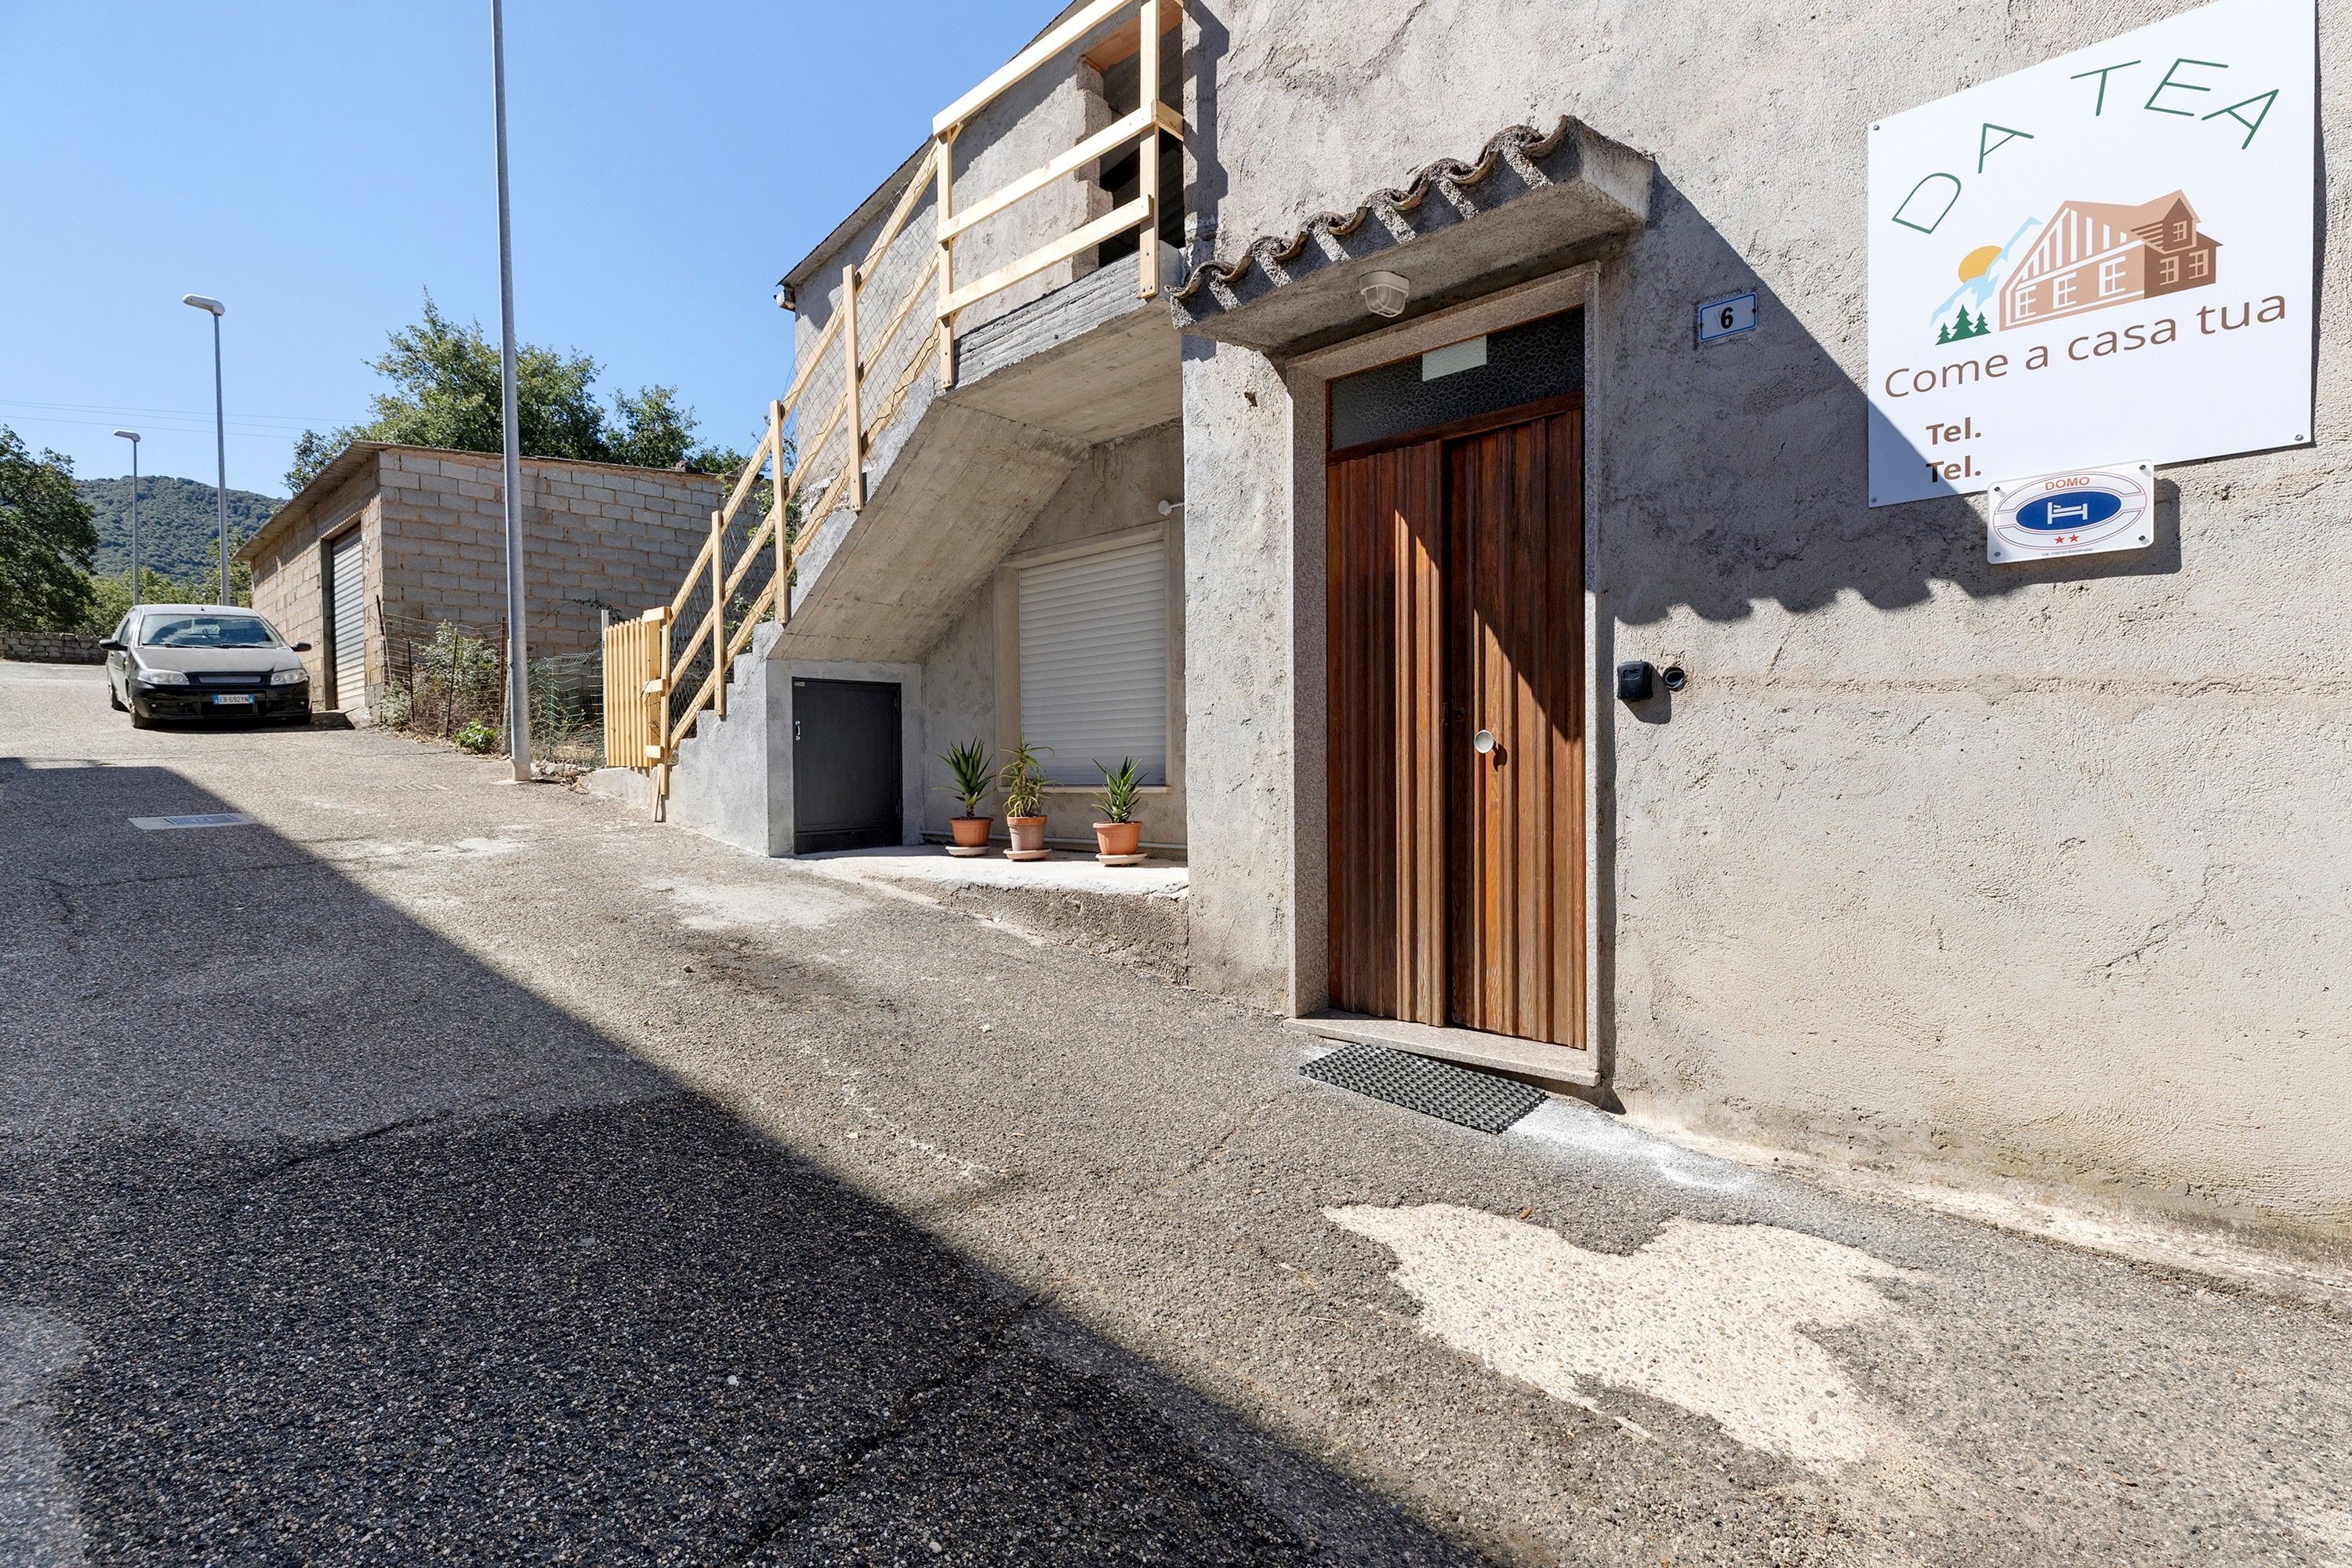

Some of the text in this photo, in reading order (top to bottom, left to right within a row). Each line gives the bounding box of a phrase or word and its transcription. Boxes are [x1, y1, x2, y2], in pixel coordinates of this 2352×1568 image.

[1891, 58, 2280, 234] DA TEA
[1720, 307, 1734, 329] 6
[1885, 295, 2286, 398] Come a casa tua
[1926, 417, 1981, 445] Tel.
[1926, 455, 1981, 483] Tel.
[2045, 476, 2090, 491] DOMO
